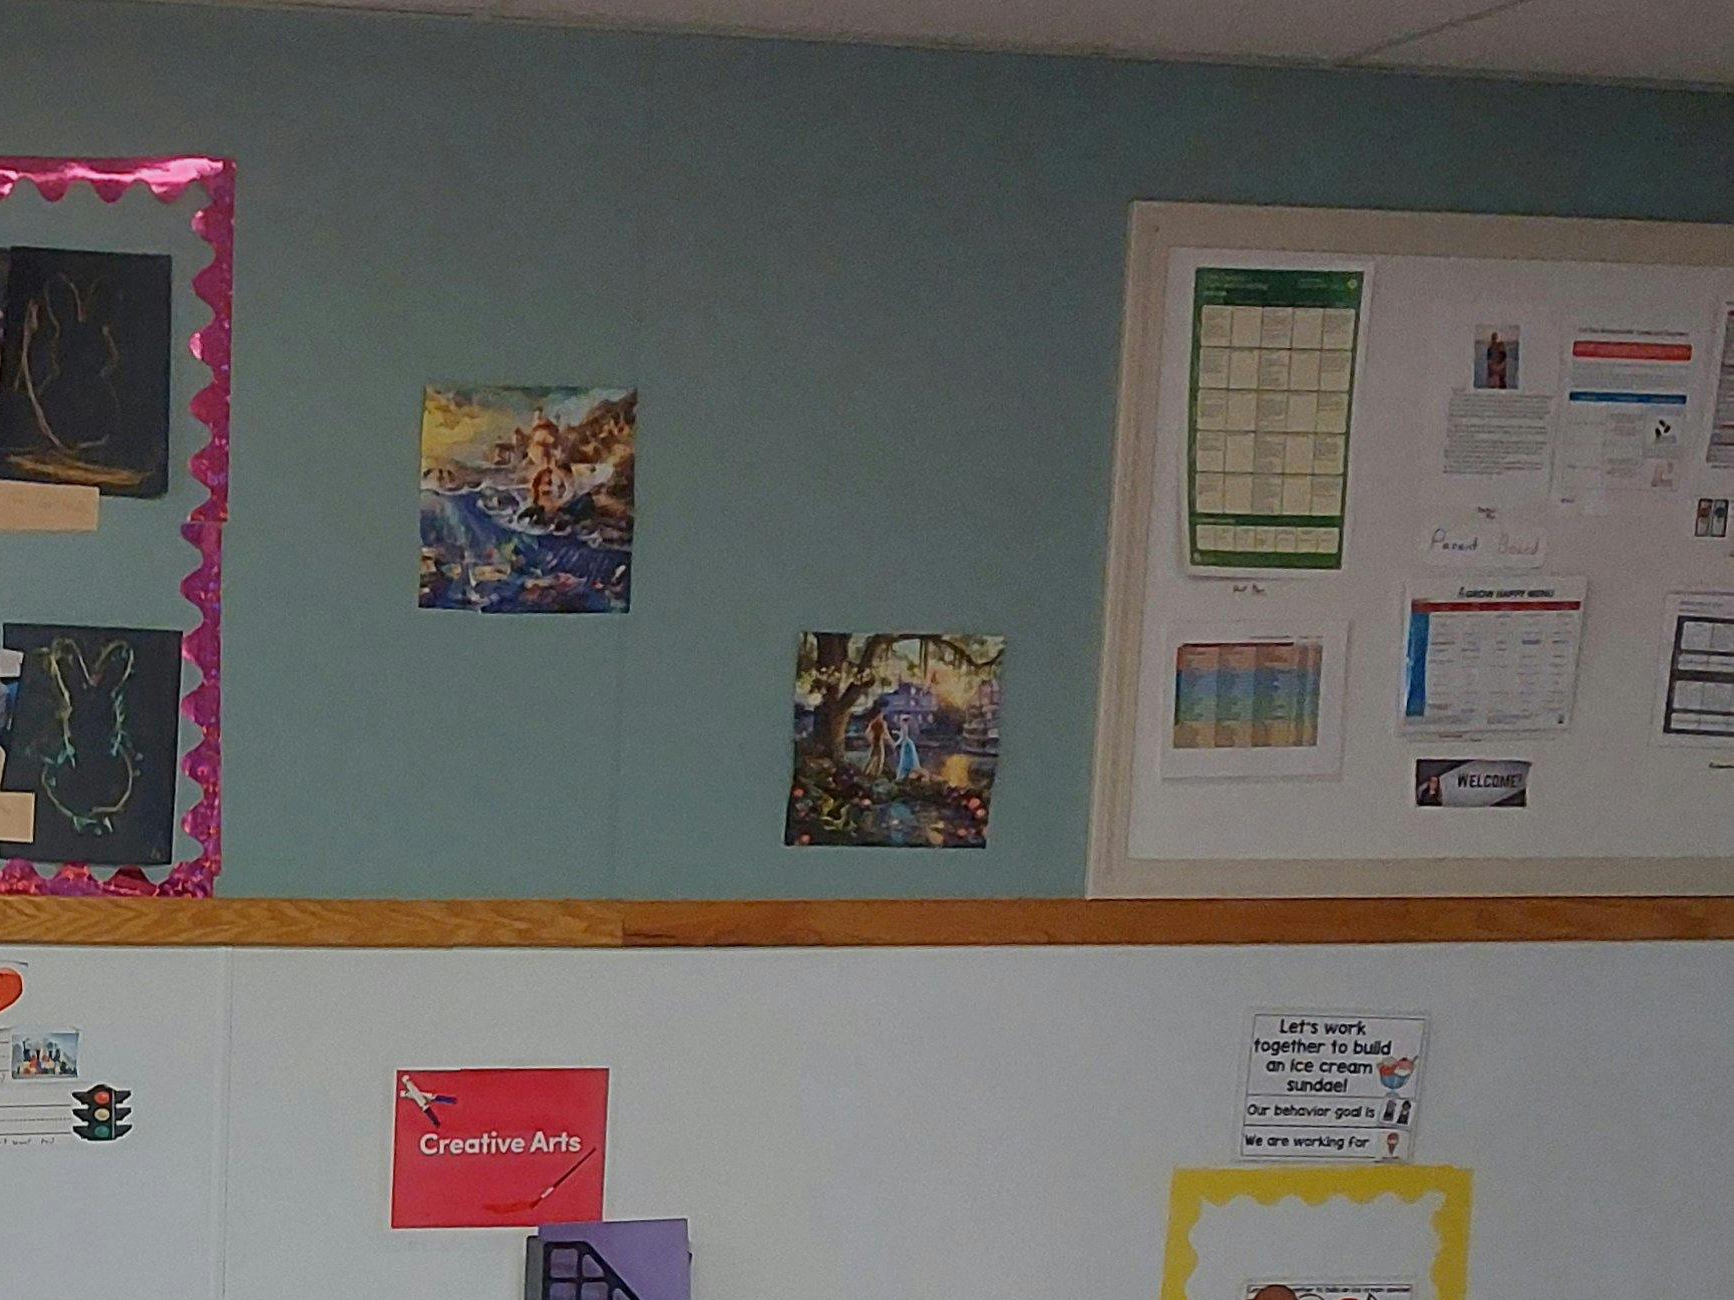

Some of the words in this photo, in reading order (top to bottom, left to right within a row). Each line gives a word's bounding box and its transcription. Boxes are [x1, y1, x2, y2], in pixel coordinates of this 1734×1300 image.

[1280, 1018, 1319, 1035] Let's
[1324, 1020, 1367, 1036] work
[1254, 1039, 1326, 1056] together
[1331, 1040, 1348, 1055] to
[1353, 1041, 1392, 1056] build
[1266, 1062, 1285, 1073] an
[1290, 1060, 1314, 1073] ice
[1319, 1061, 1373, 1075] cream
[1287, 1078, 1349, 1093] sundae!
[1247, 1104, 1270, 1116] Our
[1274, 1104, 1331, 1117] behavior
[1335, 1106, 1362, 1120] goal
[1366, 1106, 1376, 1119] is
[420, 1131, 526, 1155] Creative
[529, 1130, 582, 1153] Arts
[1244, 1135, 1263, 1147] We
[1267, 1136, 1290, 1147] are
[1293, 1135, 1345, 1150] working
[1348, 1136, 1370, 1149] for
